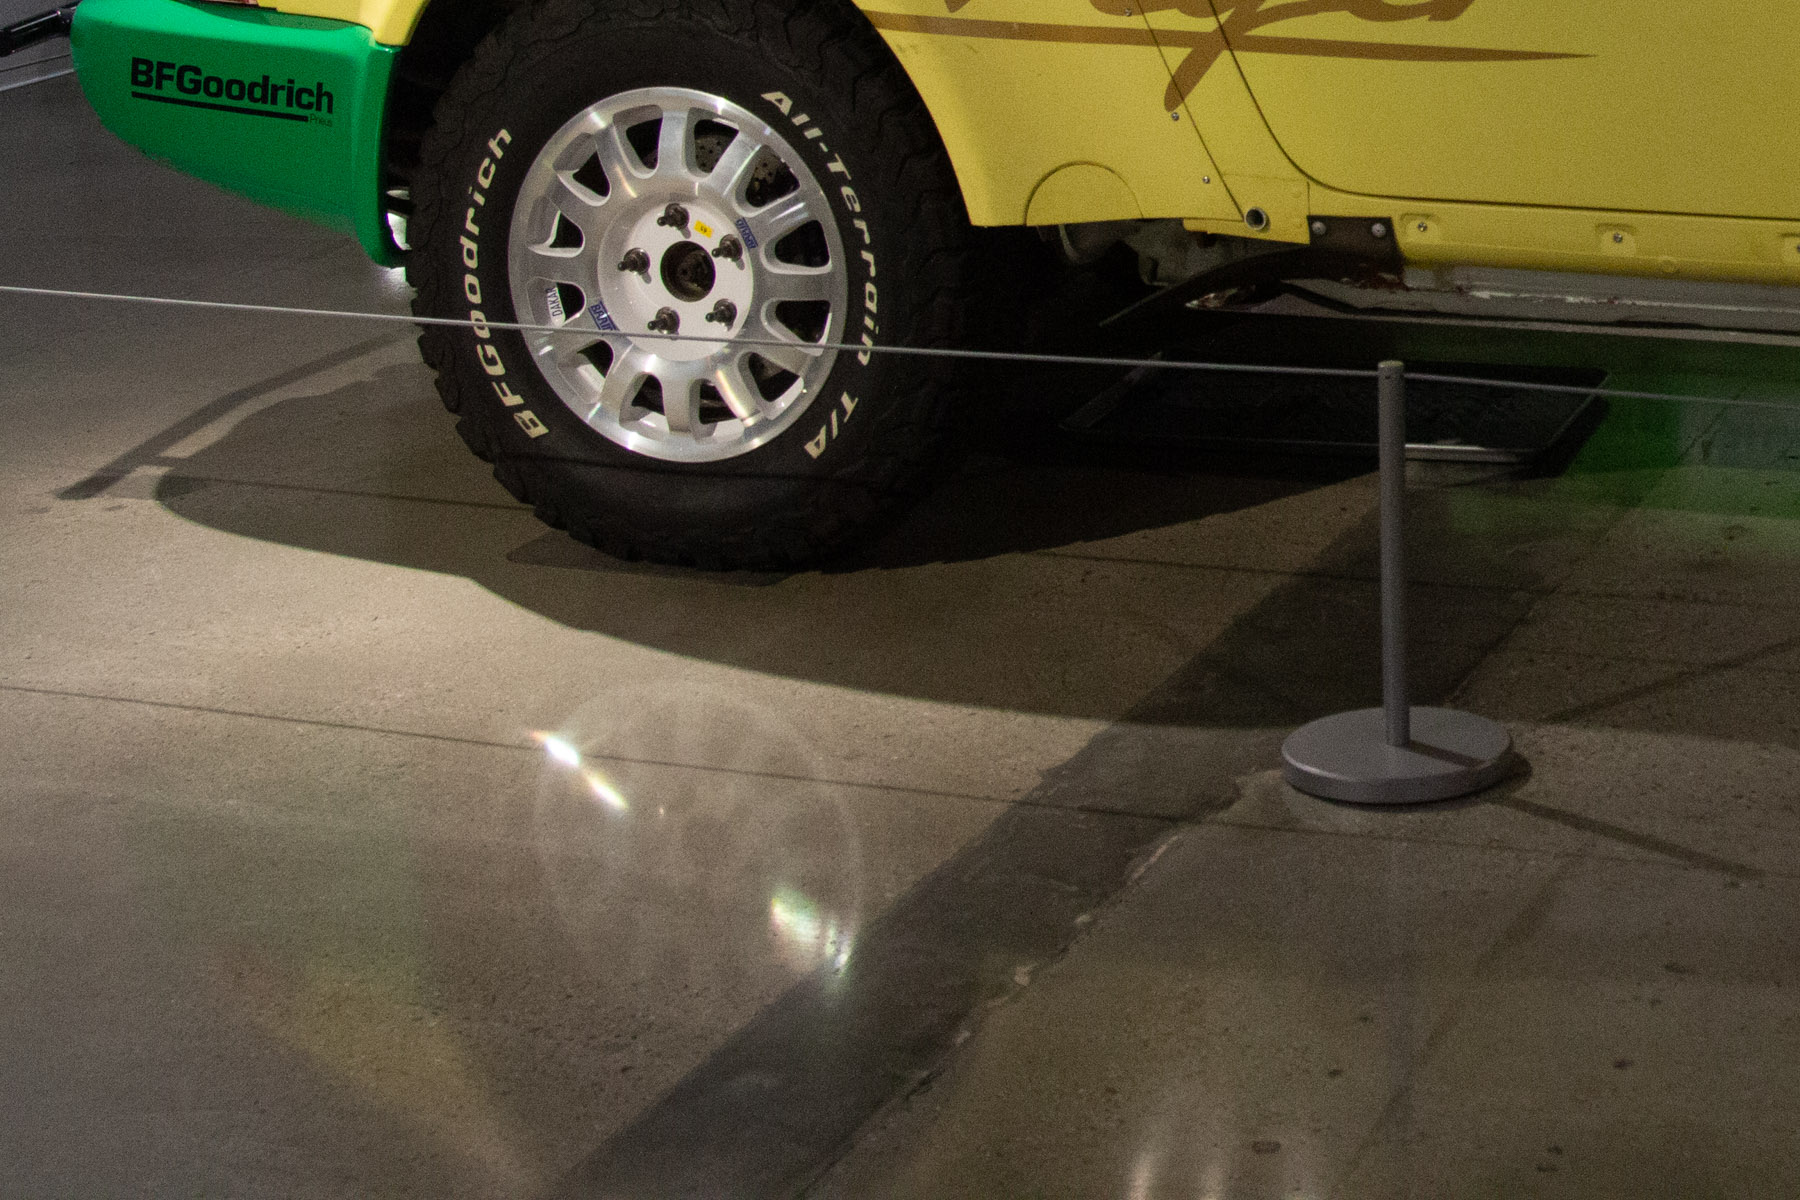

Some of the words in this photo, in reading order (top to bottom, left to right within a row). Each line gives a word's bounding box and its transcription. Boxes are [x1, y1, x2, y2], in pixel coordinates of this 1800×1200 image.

[131, 56, 334, 115] BFGoodrich
[309, 113, 333, 128] Pneus
[458, 127, 550, 440] BFGoodrich
[760, 88, 883, 367] All-Terrain
